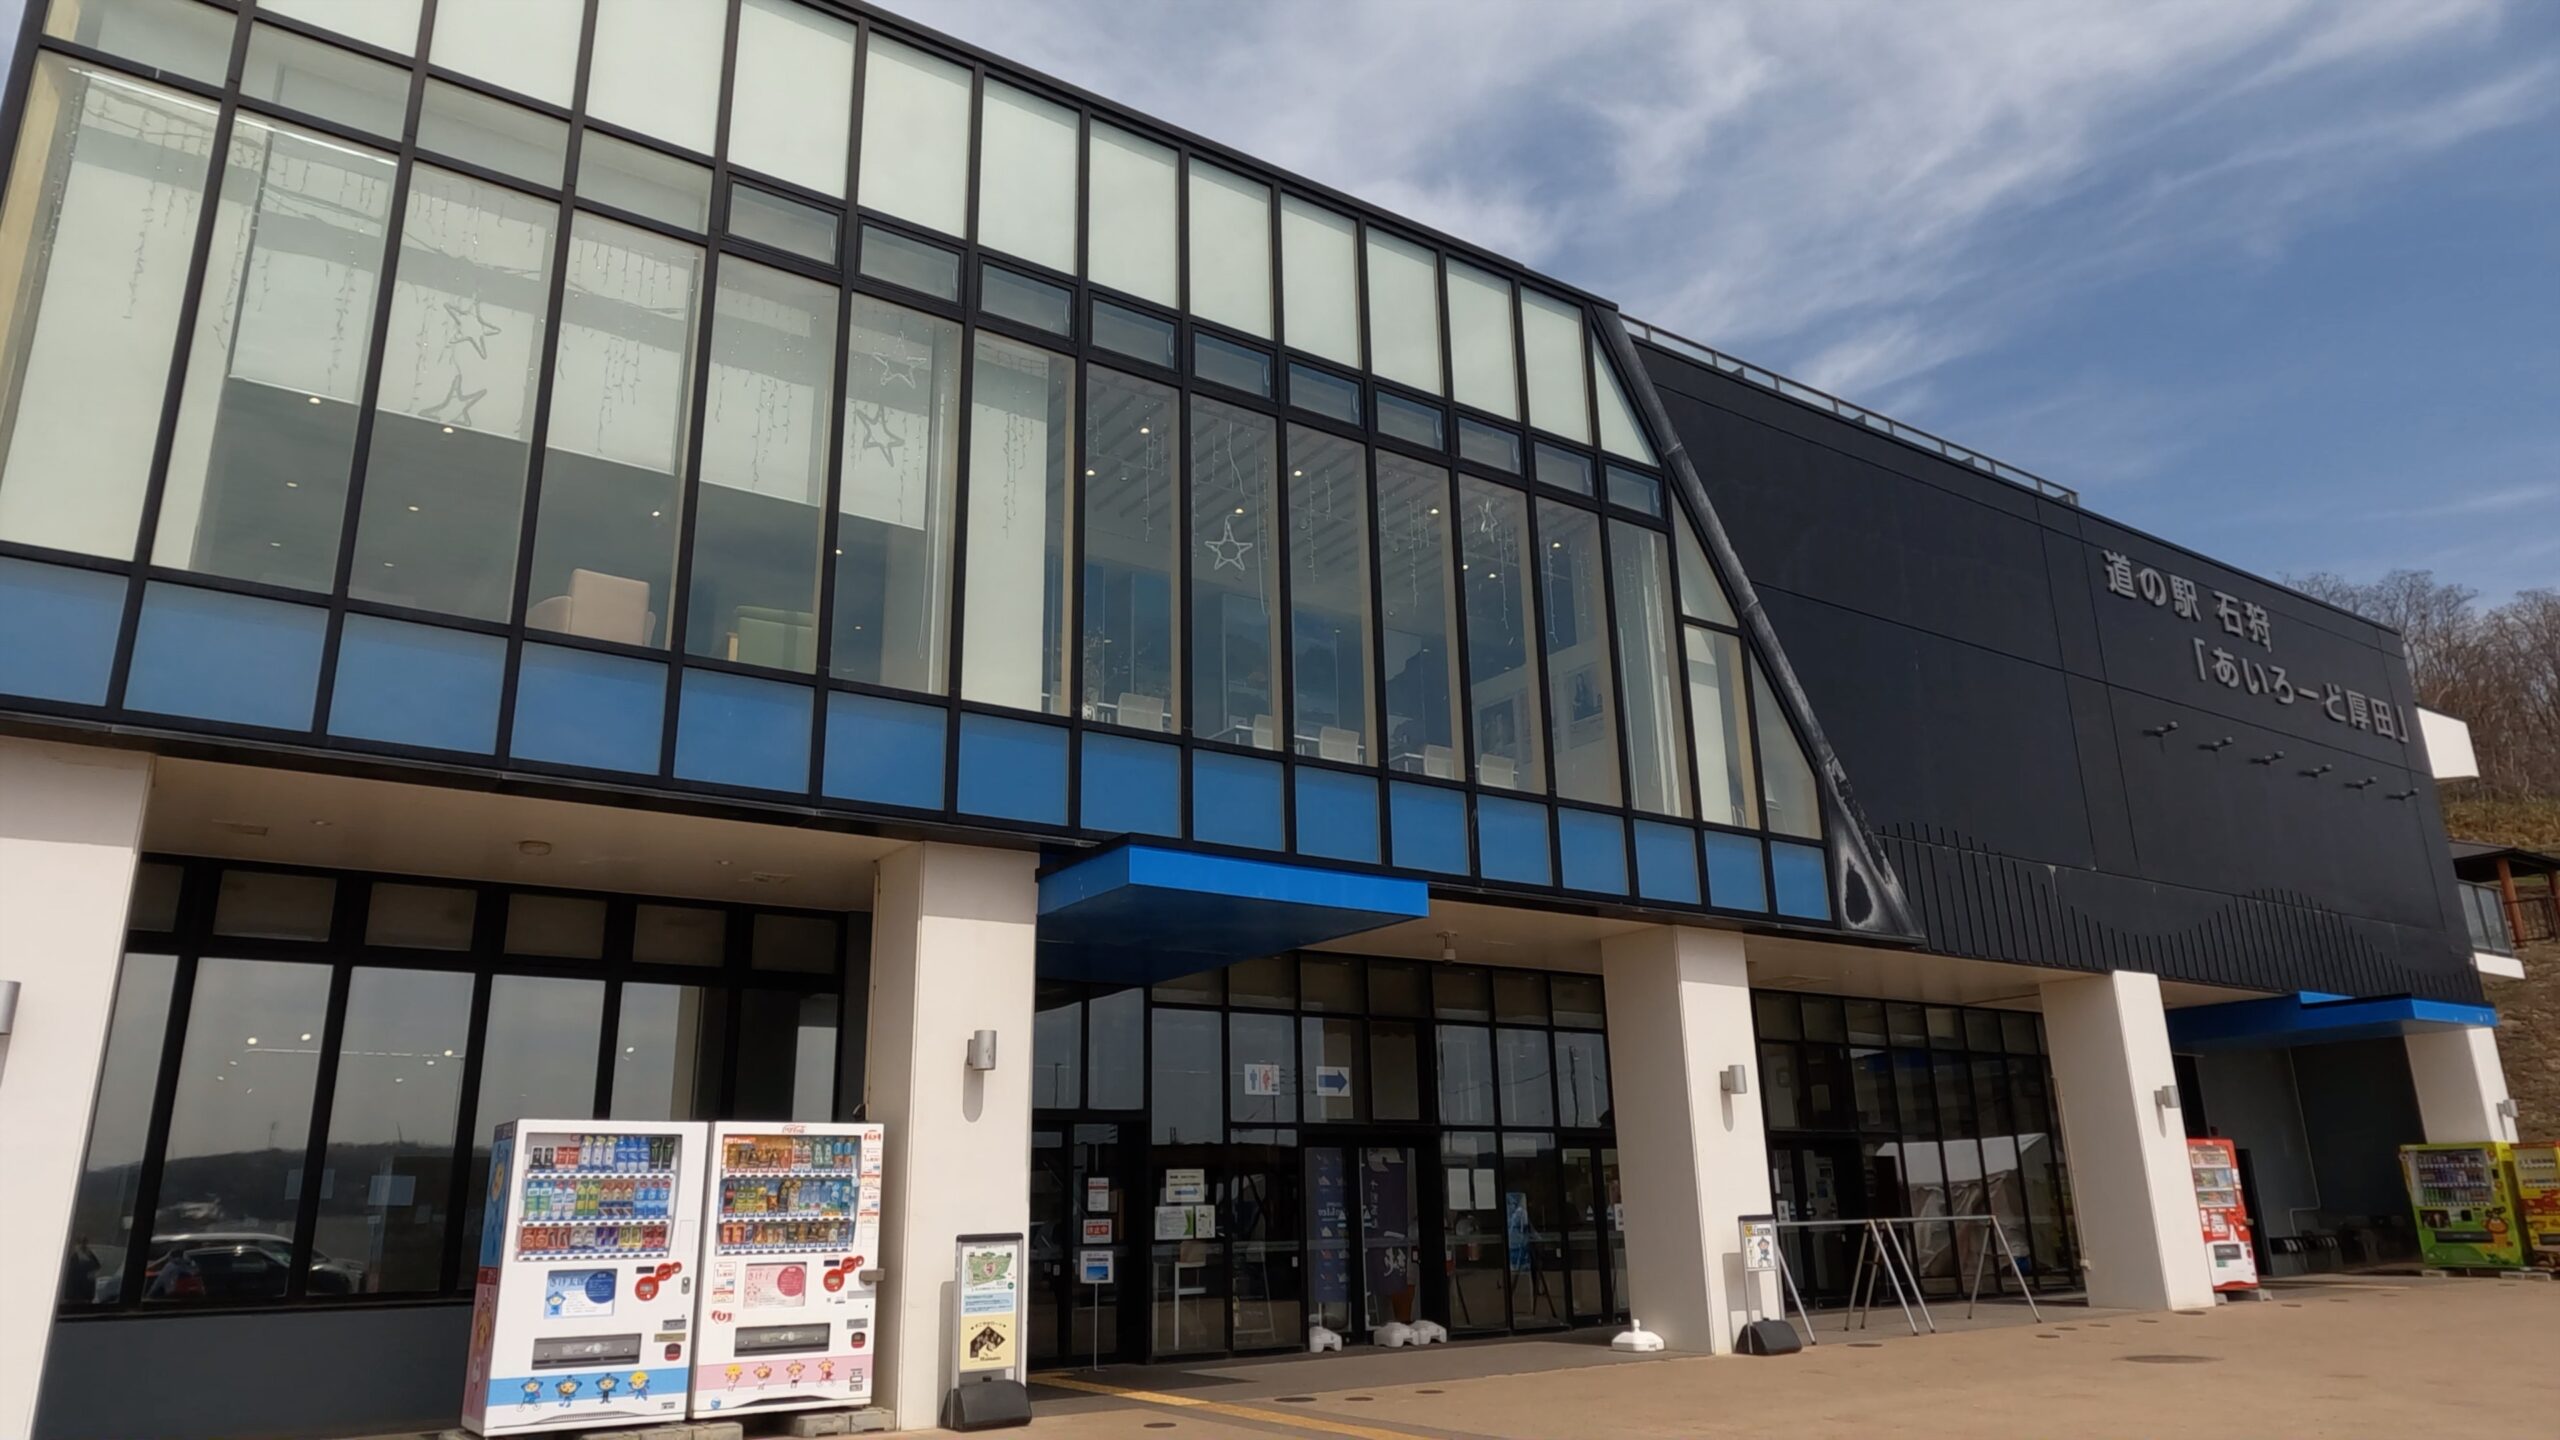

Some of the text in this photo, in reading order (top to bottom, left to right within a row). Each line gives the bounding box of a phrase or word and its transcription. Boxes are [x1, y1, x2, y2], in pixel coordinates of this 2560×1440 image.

[2102, 549, 2273, 653] 道の駅 石狩
[2193, 637, 2410, 744] 「あいろーど厚田」
